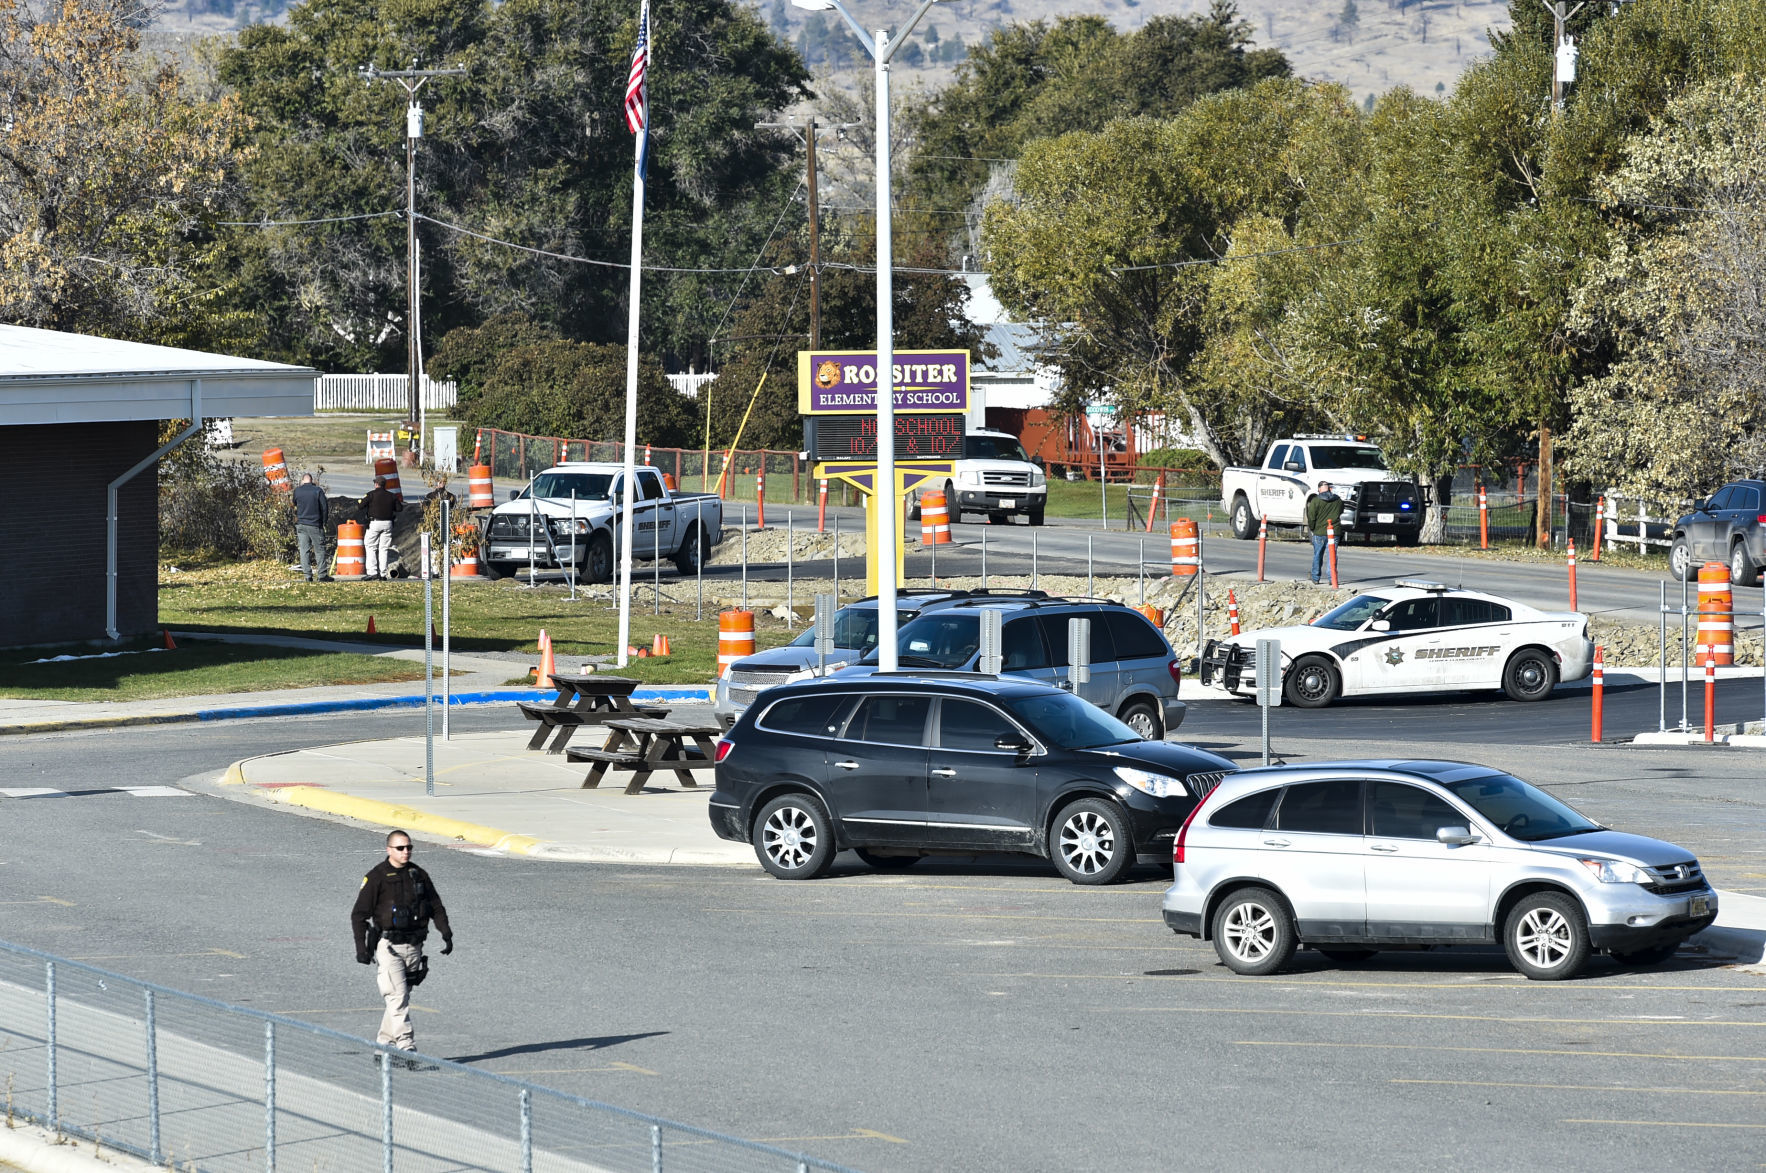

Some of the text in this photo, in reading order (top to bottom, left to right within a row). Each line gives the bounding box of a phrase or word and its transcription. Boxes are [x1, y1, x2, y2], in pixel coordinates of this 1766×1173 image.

[843, 363, 958, 384] ROSITER
[819, 392, 960, 405] ELEMENTRY SCHOOL
[895, 417, 961, 436] SCHOOL
[906, 437, 919, 454] &
[1260, 489, 1286, 497] SHERIFF
[1414, 645, 1501, 660] SHERIFF
